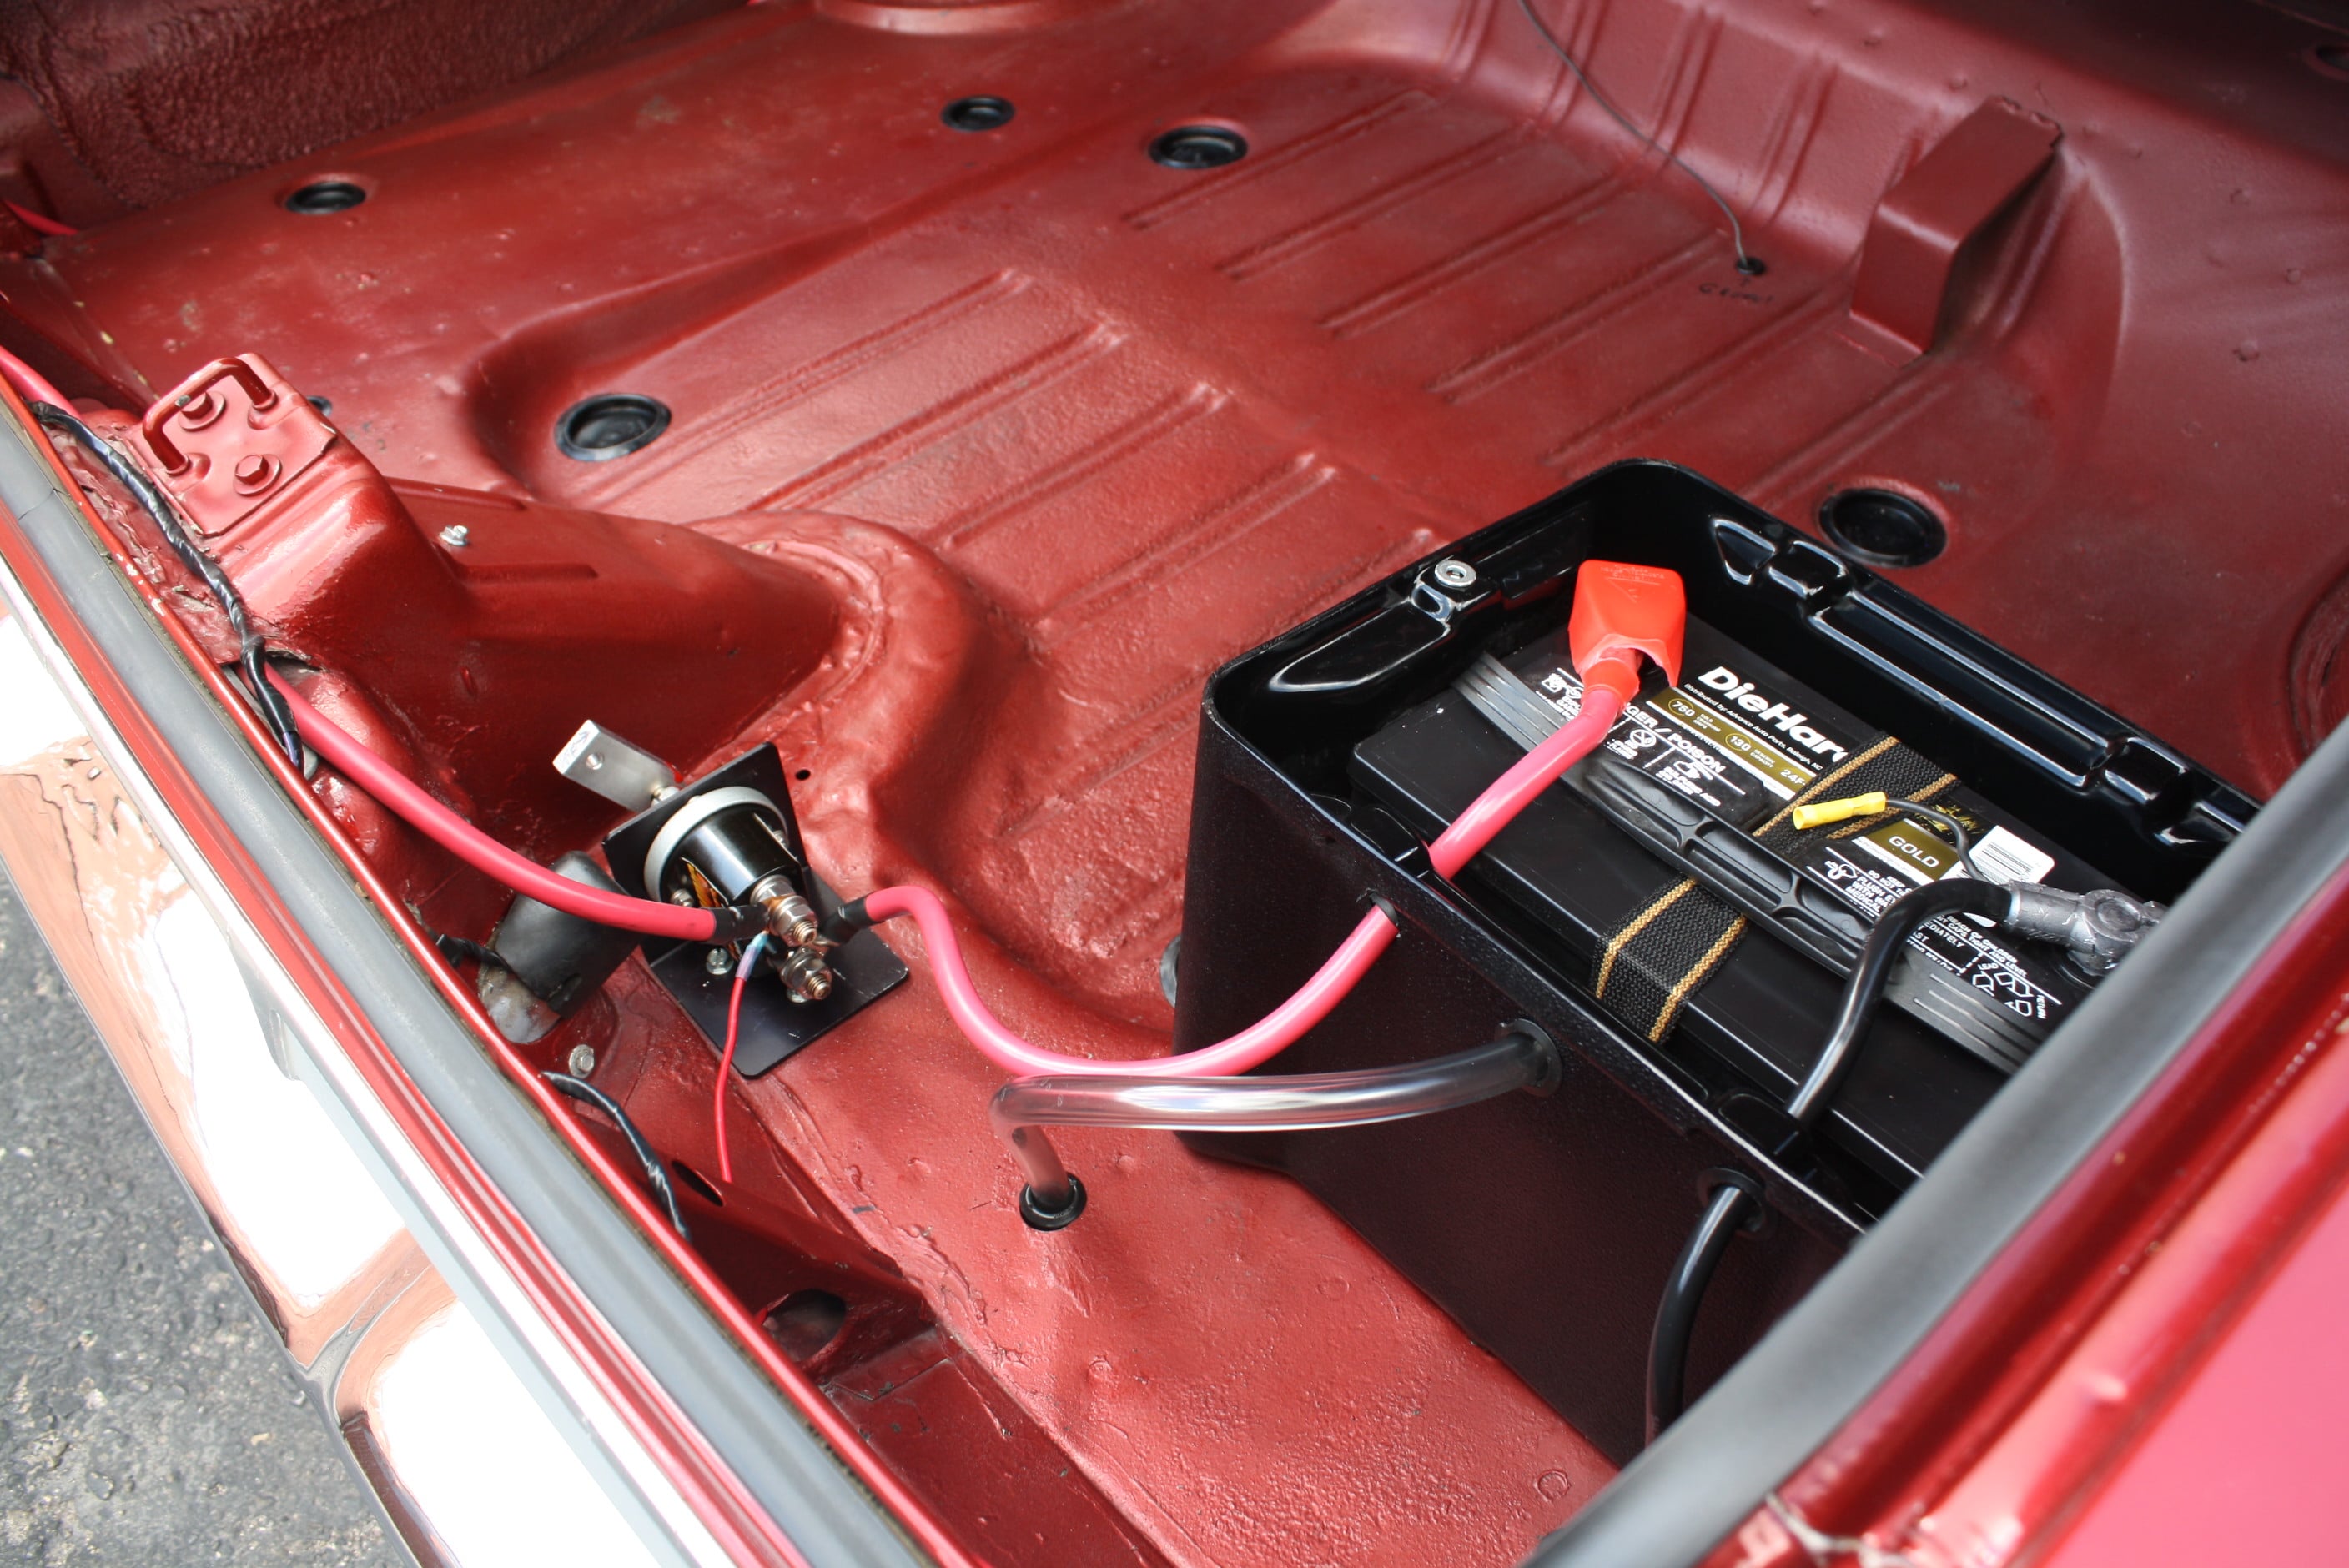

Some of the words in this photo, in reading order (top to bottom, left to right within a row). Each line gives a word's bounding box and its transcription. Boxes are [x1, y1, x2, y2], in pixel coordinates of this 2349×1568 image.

[1684, 684, 1718, 706] Distributed
[1727, 711, 1753, 727] Advance
[1753, 726, 1768, 736] Auto
[1698, 666, 1848, 763] DieHar
[1626, 703, 1658, 729] GER
[1667, 732, 1726, 773] POISON
[1730, 734, 1752, 751] 130
[1888, 835, 1939, 869] GOLD
[1851, 881, 1875, 897] WITH
[1856, 876, 1885, 897] FLUSH
[1879, 877, 1896, 888] NOT
[1844, 887, 1882, 912] MEDICAL
[1924, 922, 1965, 947] EDIATELY
[1946, 916, 1971, 934] REACH
[1982, 940, 2018, 964] CHILDREN
[1947, 923, 1968, 937] CAPS
[1969, 937, 1991, 951] TIGHT
[1989, 951, 2008, 963] AND
[1978, 962, 1999, 972] LEAD
[2035, 993, 2047, 1019] RETURN
